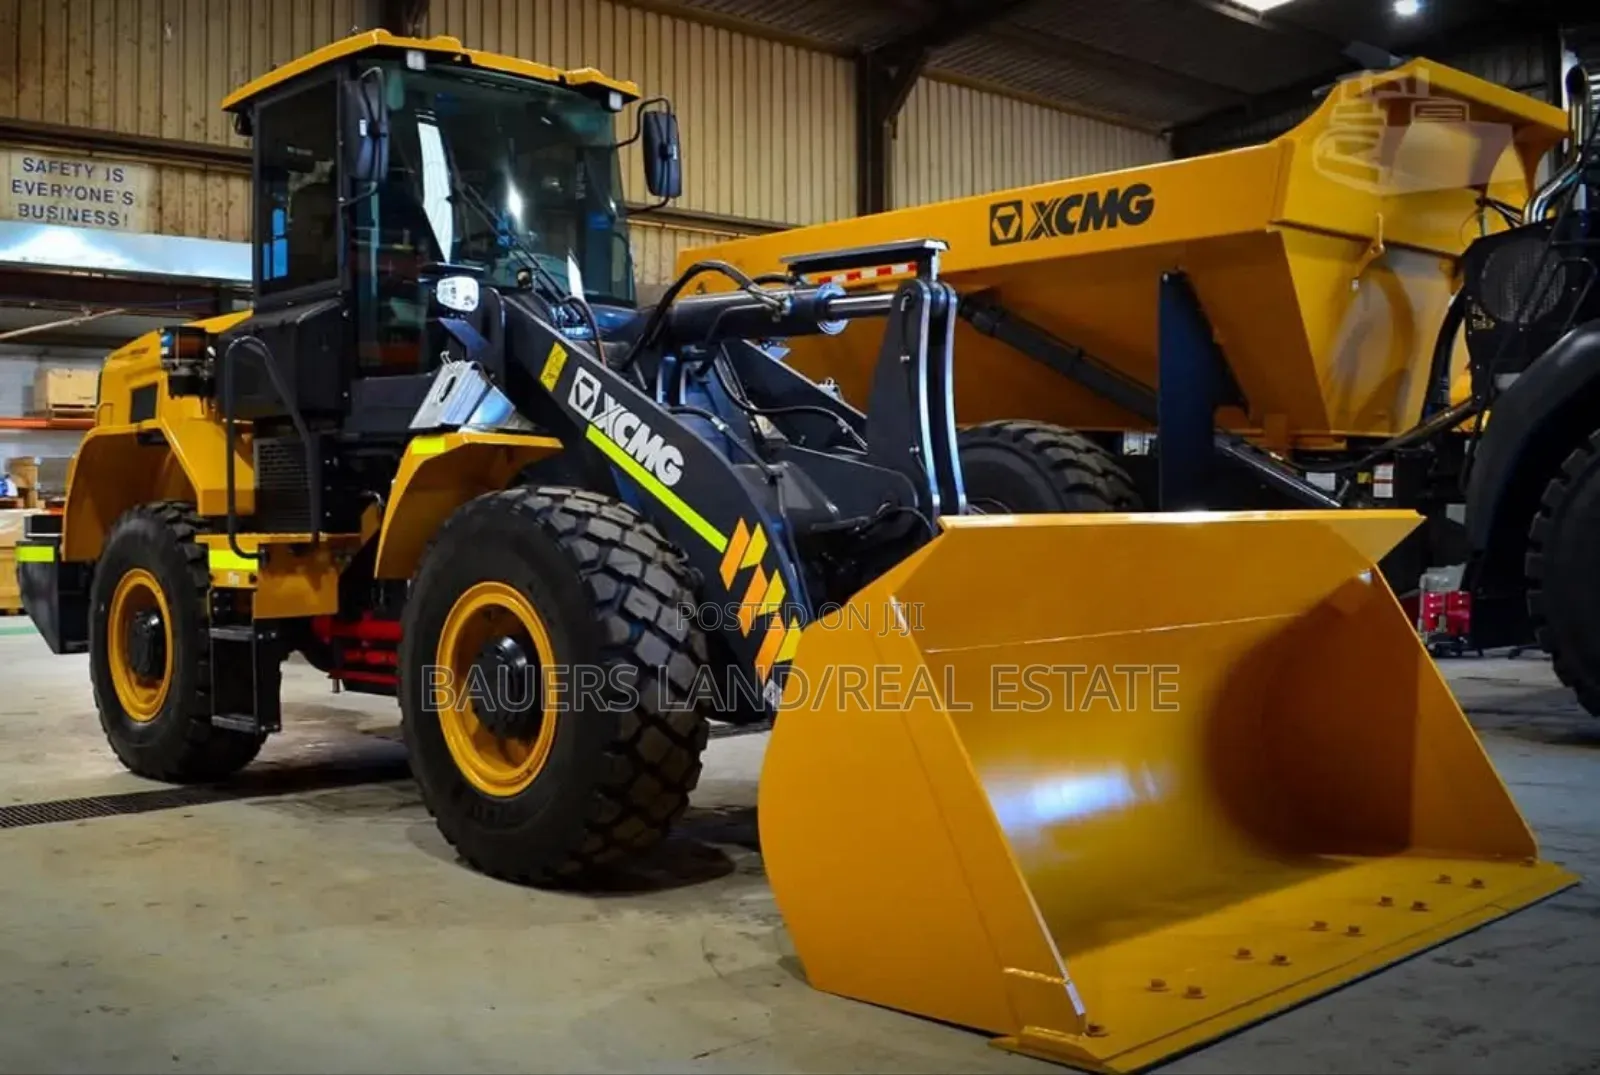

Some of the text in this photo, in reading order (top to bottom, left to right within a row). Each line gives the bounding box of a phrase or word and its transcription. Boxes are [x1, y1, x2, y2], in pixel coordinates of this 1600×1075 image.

[22, 157, 124, 183] SAFETY IS
[12, 179, 134, 206] EVERYONE'S
[18, 203, 128, 227] BUSINESS!
[1023, 183, 1155, 241] XCMG
[590, 392, 685, 487] XCMG
